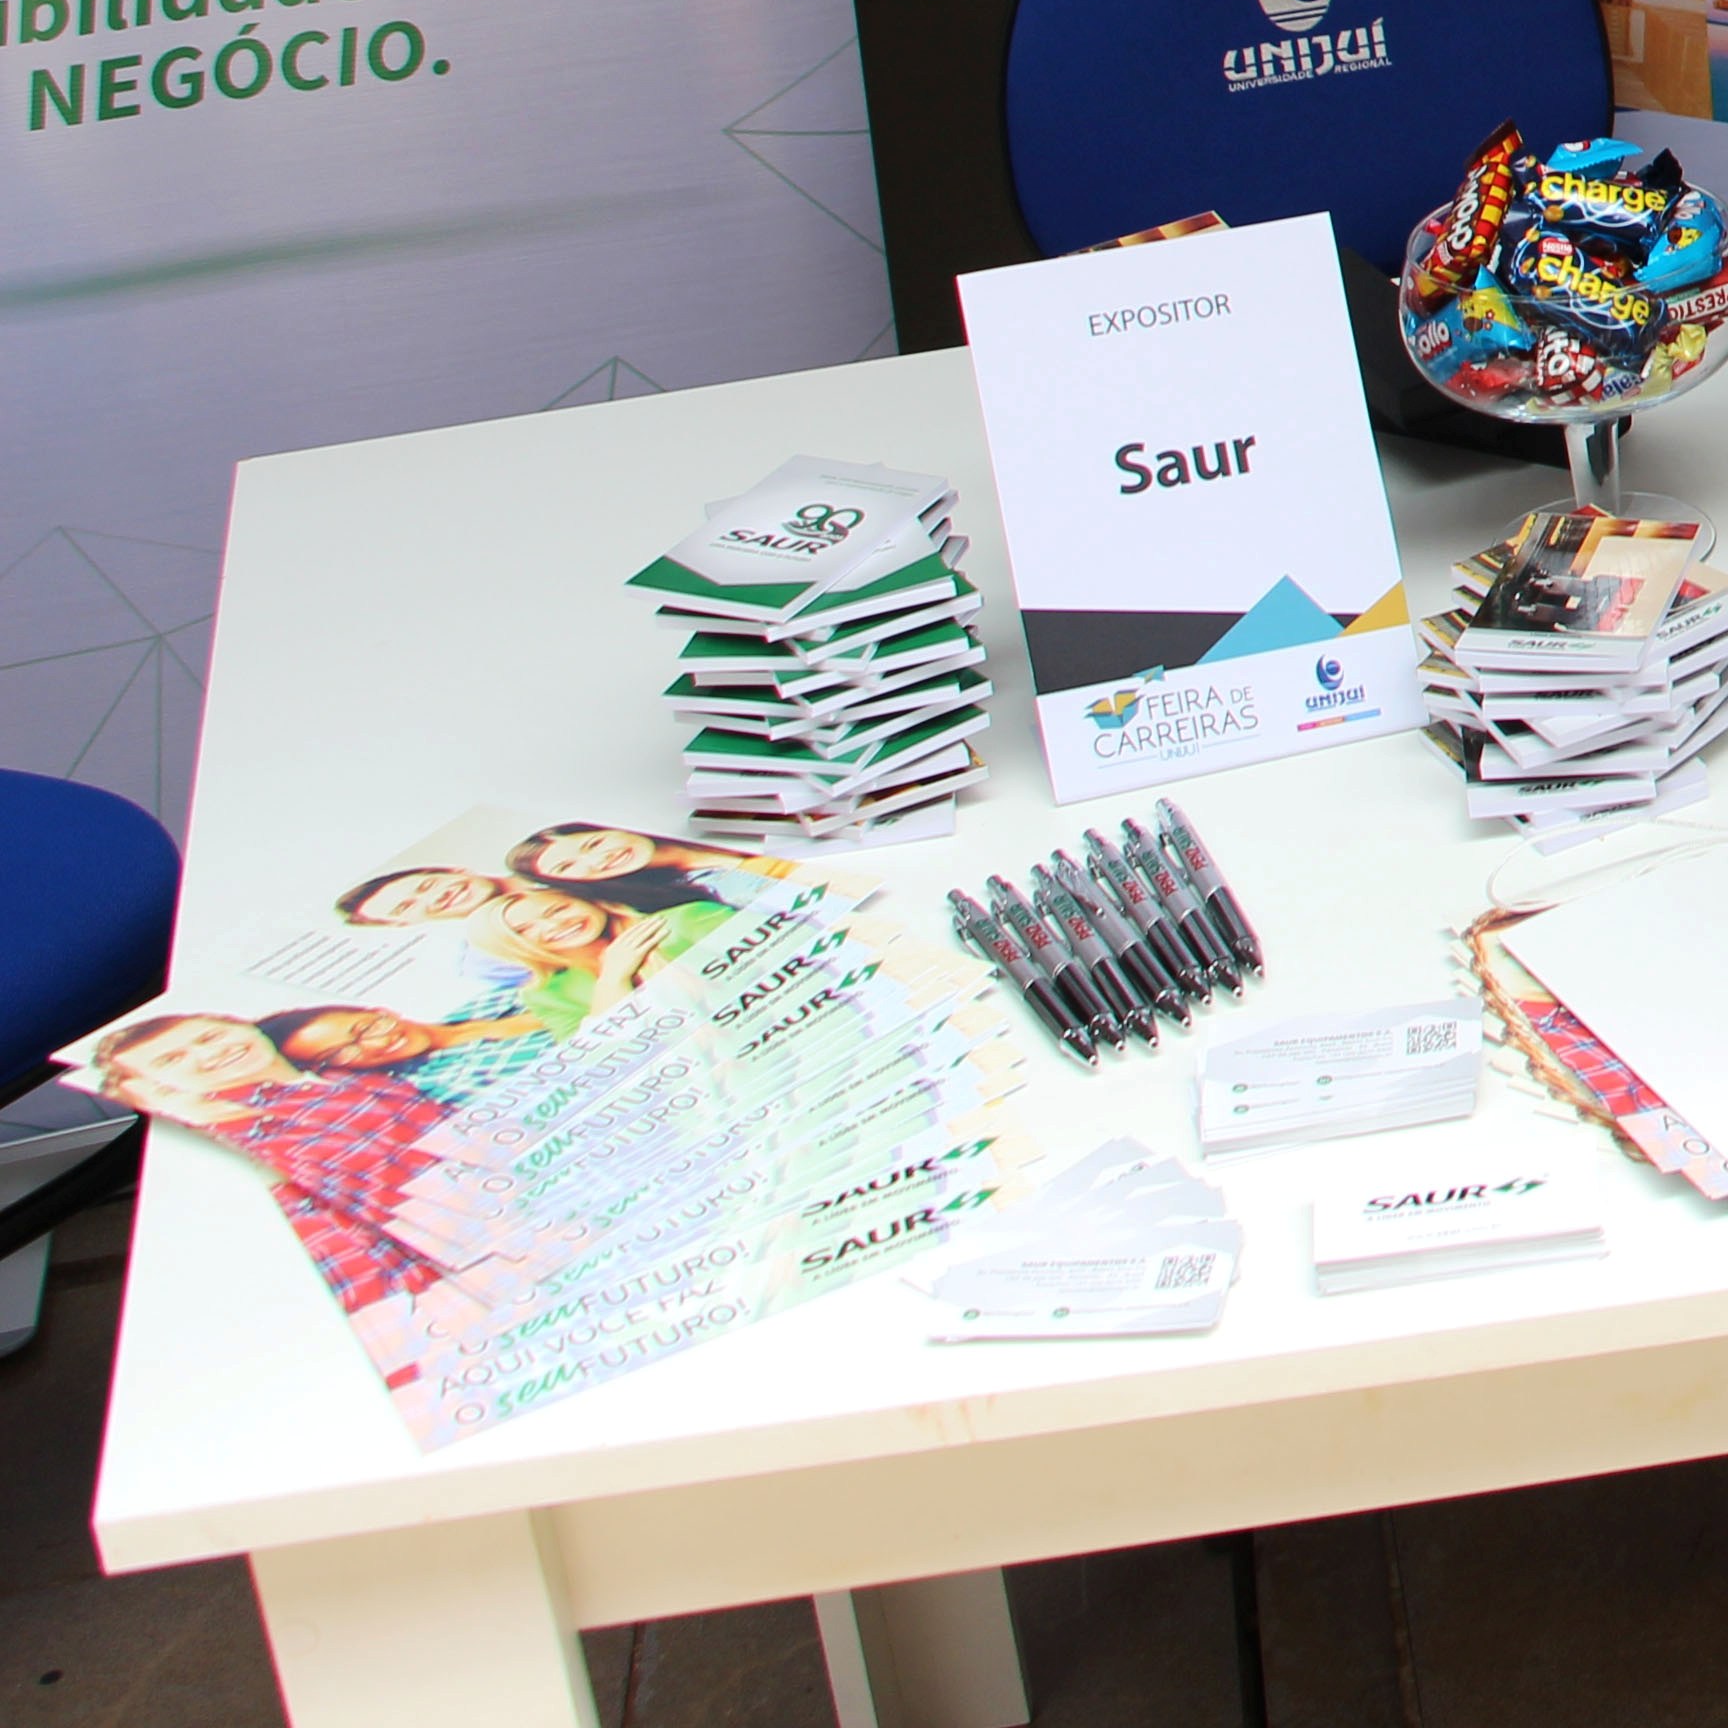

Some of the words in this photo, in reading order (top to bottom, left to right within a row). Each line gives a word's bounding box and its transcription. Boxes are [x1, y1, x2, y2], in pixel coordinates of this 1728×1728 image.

[28, 19, 452, 132] NEGÓCIO.
[1223, 16, 1388, 82] UNIJUÍ
[1228, 70, 1314, 93] UNIVERSIDADE
[1334, 57, 1392, 74] REGIONAL
[1540, 171, 1669, 213] charge
[1088, 292, 1233, 338] EXPOSITOR
[1537, 255, 1651, 326] charge
[1113, 433, 1257, 496] Saur
[719, 528, 829, 556] SAUR
[1093, 704, 1260, 759] CARREIRAS
[1146, 685, 1225, 721] FEIRA
[1230, 685, 1255, 705] DE
[701, 909, 798, 981] SAUR
[711, 953, 816, 1028] SAUR
[453, 1087, 530, 1136] AQUI
[591, 1001, 652, 1037] FAZ
[570, 1007, 697, 1091] FUTURO!
[568, 1055, 701, 1140] FUTURO!
[1361, 1183, 1490, 1215] SAUR
[800, 1206, 939, 1275] SAUR
[580, 1239, 751, 1315] FUTURO!
[440, 1347, 536, 1399] AQUI
[454, 1402, 486, 1425] O
[577, 1296, 752, 1377] FUTURO!
